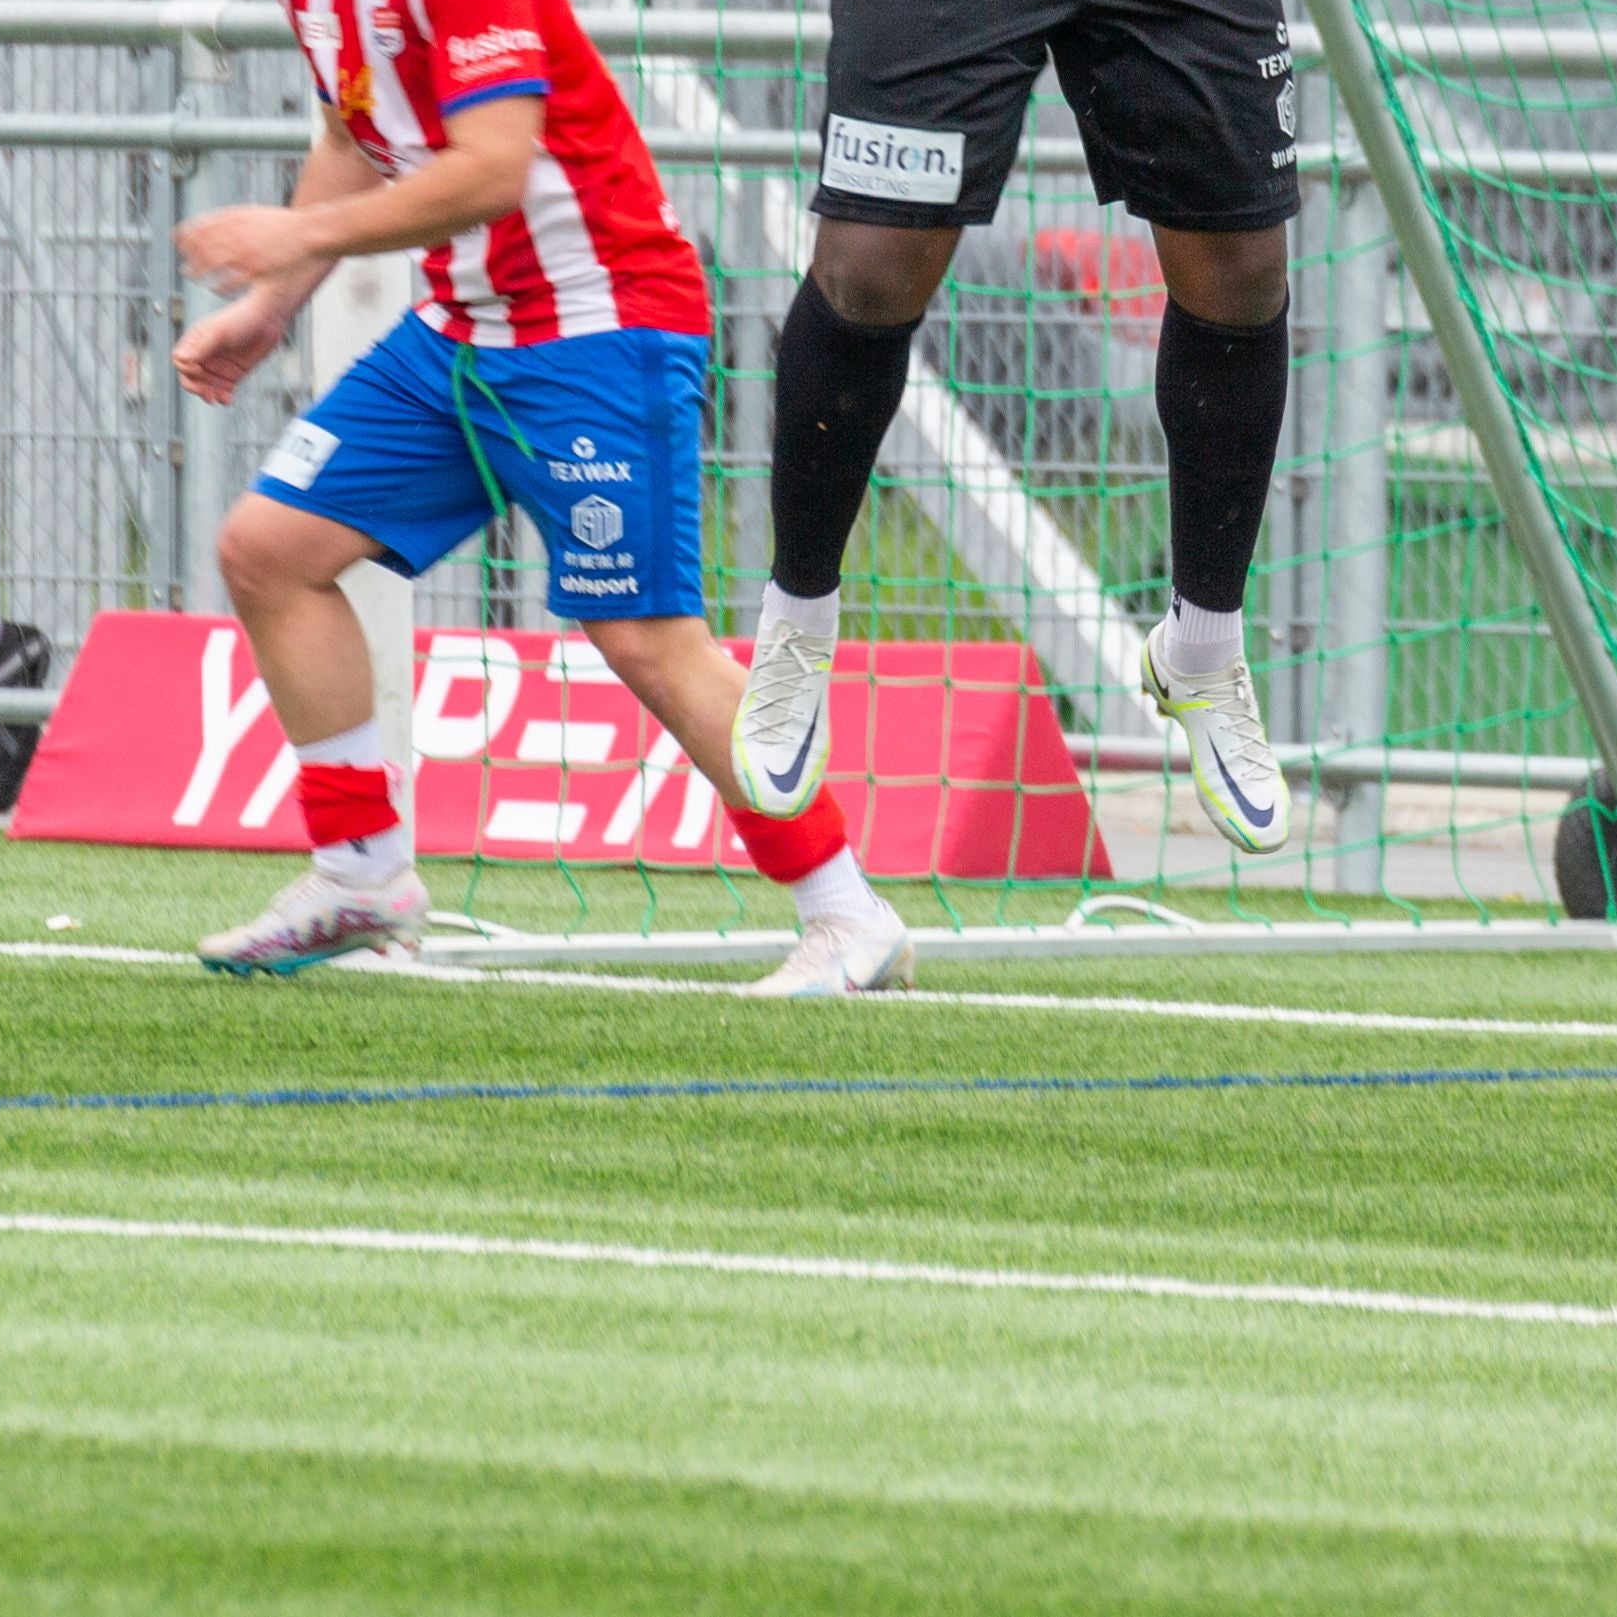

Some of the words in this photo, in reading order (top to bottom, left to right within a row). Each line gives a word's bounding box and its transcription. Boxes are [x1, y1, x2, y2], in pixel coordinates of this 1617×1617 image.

[832, 122, 957, 176] fusion.
[547, 460, 633, 483] TEXWAX
[559, 573, 640, 599] uhlsport
